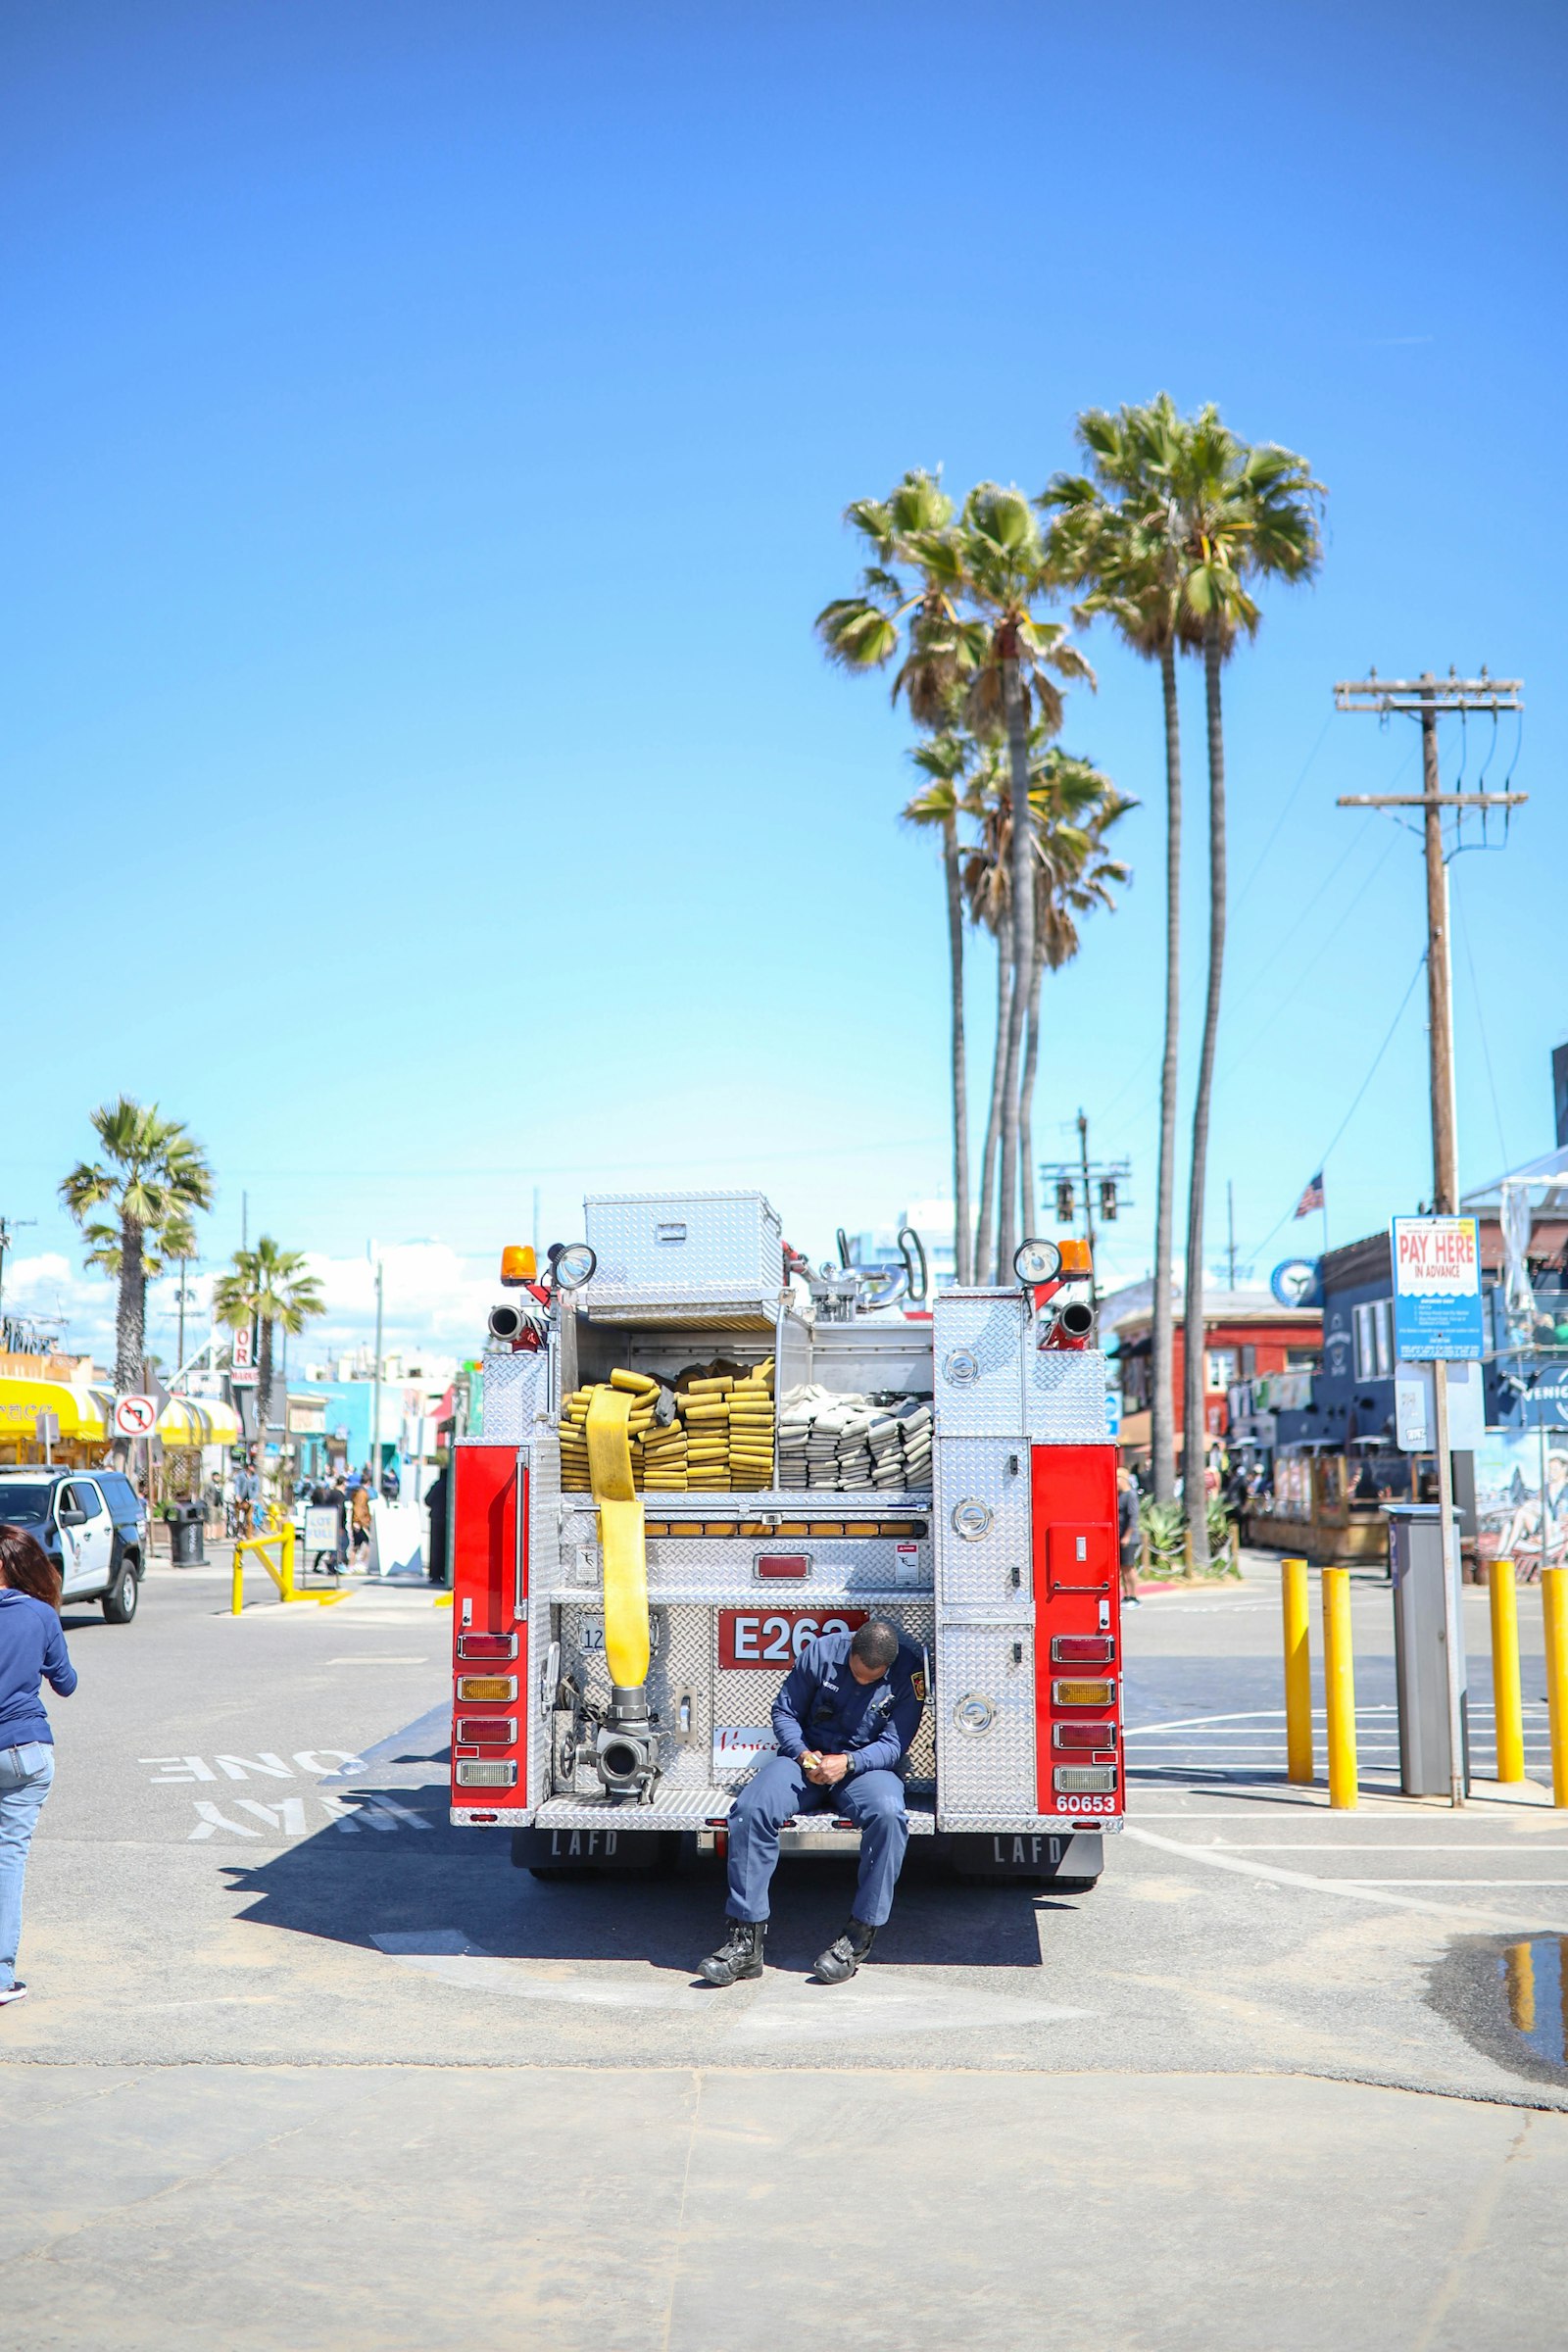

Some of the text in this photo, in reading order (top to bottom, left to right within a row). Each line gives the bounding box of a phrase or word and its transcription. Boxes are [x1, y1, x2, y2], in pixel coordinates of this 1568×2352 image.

[1399, 1235, 1475, 1263] PAY HERE
[1414, 1264, 1460, 1278] IN ADVANCE
[311, 1516, 331, 1527] LOT
[306, 1529, 335, 1540] FULL
[720, 1731, 780, 1752] Venice
[137, 1749, 368, 1784] ONE
[1056, 1795, 1116, 1813] 60653
[551, 1830, 617, 1856] LAFD
[994, 1836, 1061, 1863] LAFD
